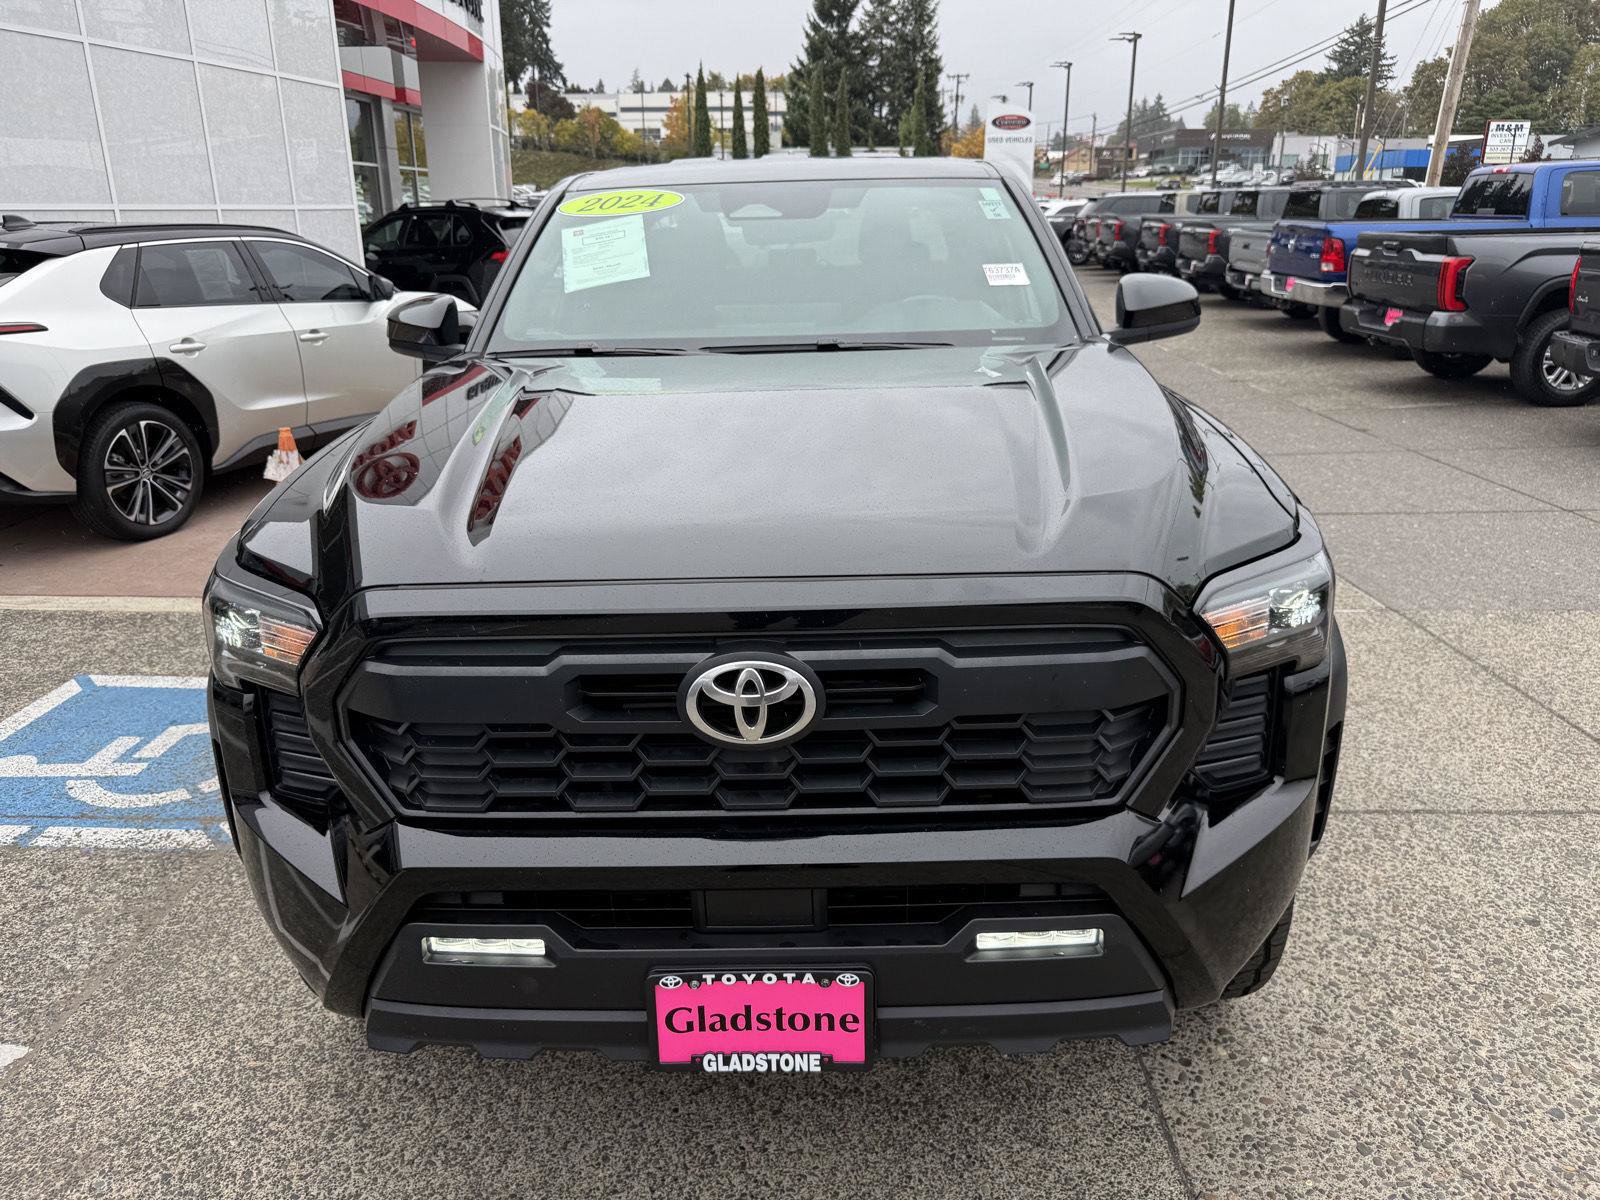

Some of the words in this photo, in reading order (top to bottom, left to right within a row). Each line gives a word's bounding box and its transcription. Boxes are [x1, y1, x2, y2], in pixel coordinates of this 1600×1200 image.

[1495, 124, 1524, 132] M&M
[577, 194, 664, 212] 2024
[702, 973, 817, 985] TOYOTA
[664, 1004, 860, 1034] Gladstone
[702, 1053, 822, 1073] GLADSTONE
